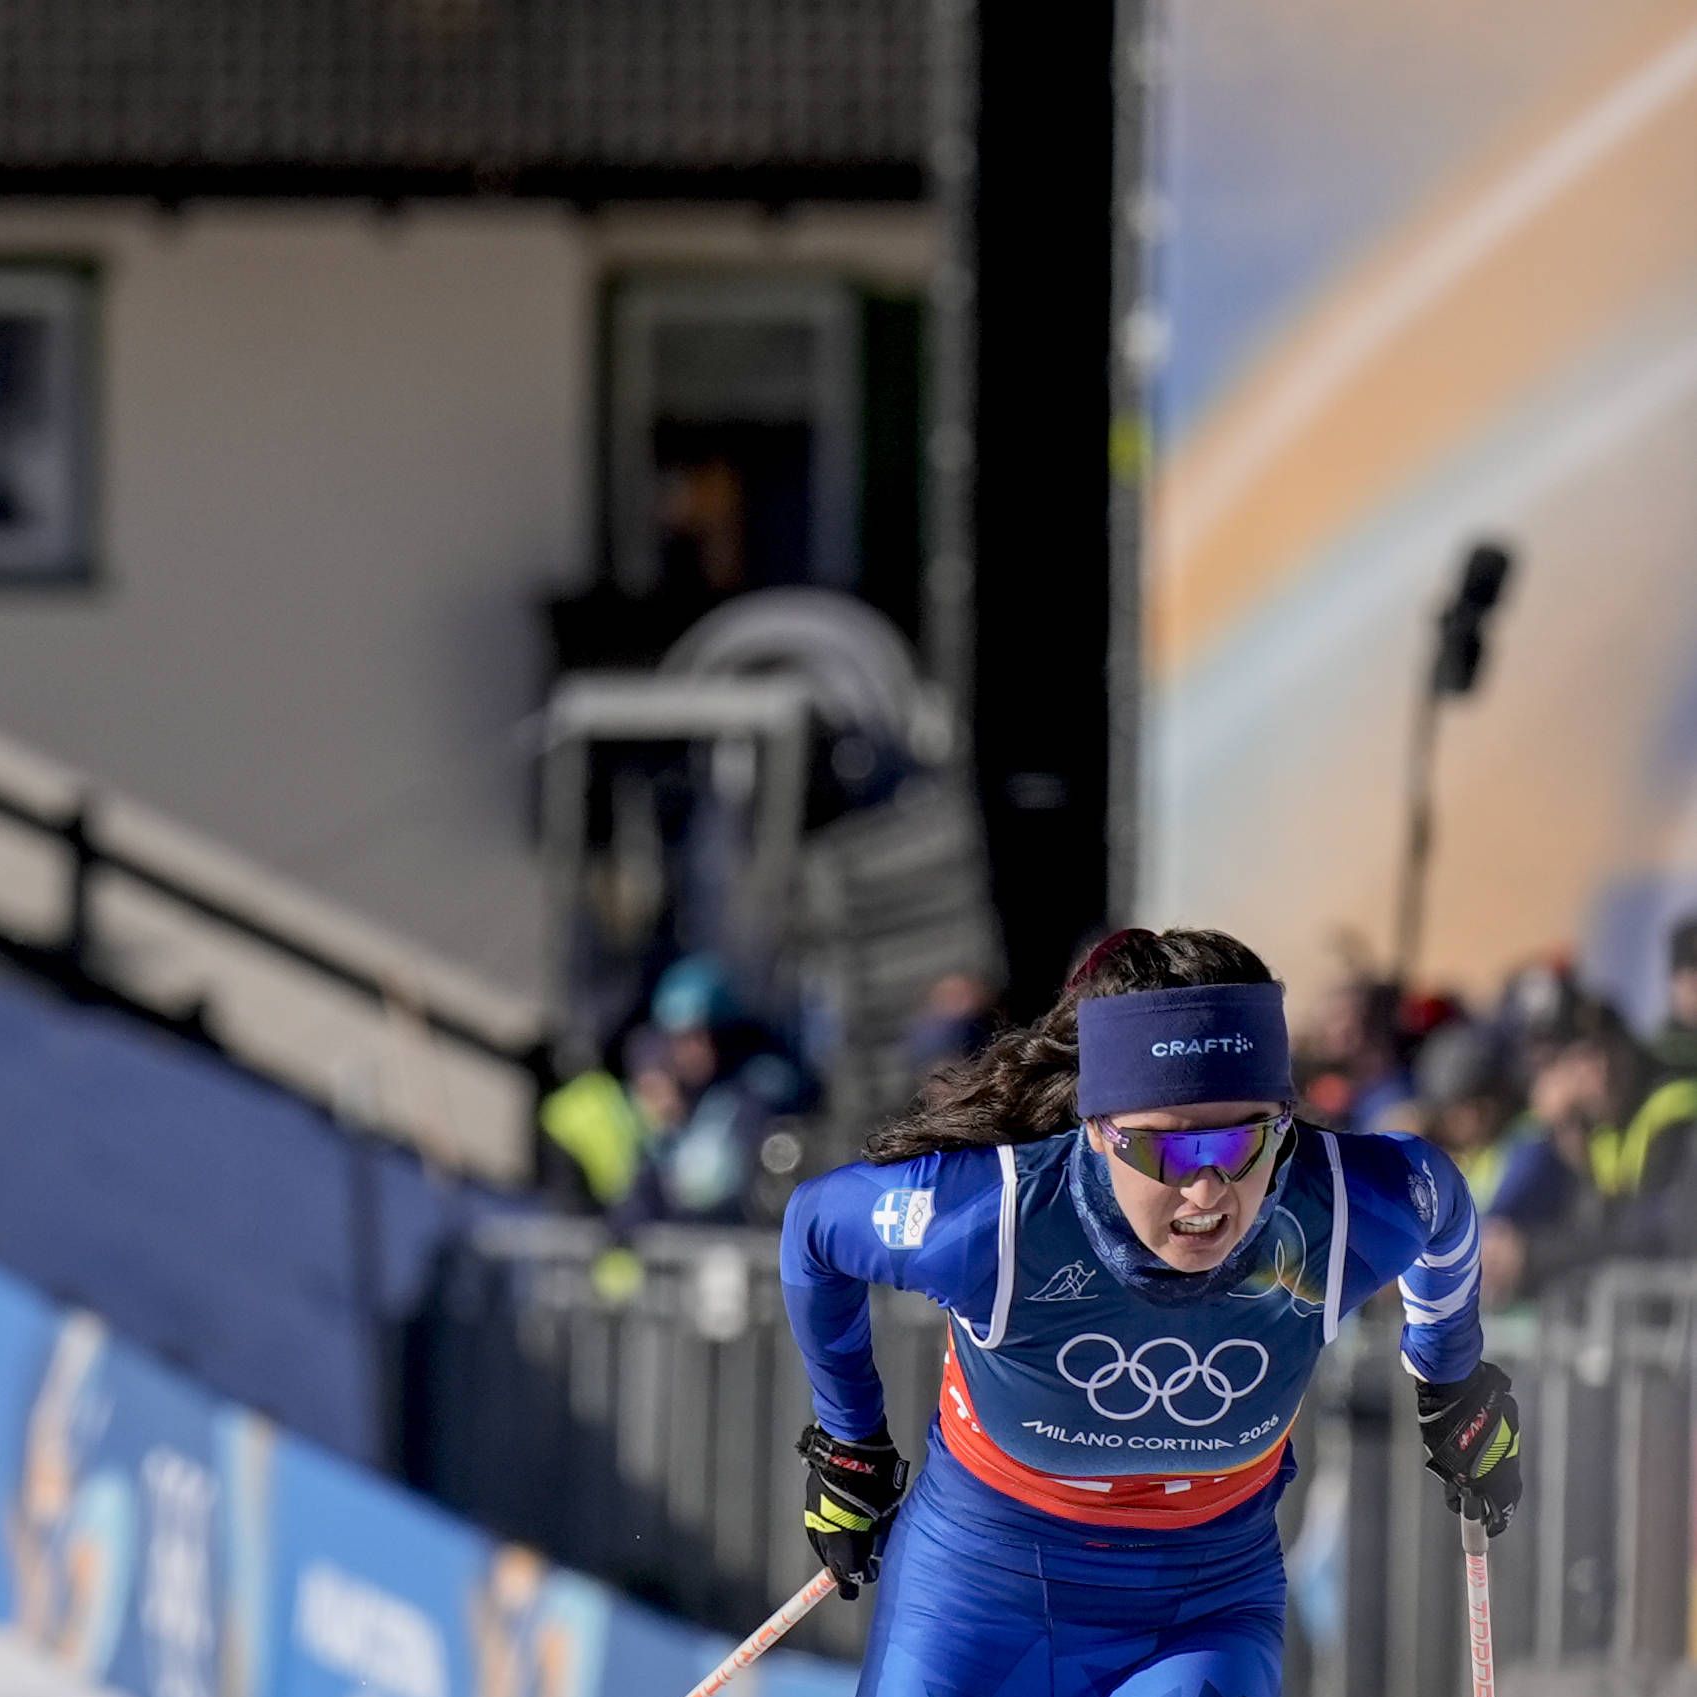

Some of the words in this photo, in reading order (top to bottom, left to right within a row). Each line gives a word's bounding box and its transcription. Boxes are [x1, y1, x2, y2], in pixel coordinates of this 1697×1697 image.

[1151, 1039, 1233, 1057] CRAFT
[1021, 1420, 1123, 1447] MILANO
[1127, 1436, 1234, 1450] CORTINA
[1239, 1414, 1279, 1444] 2026
